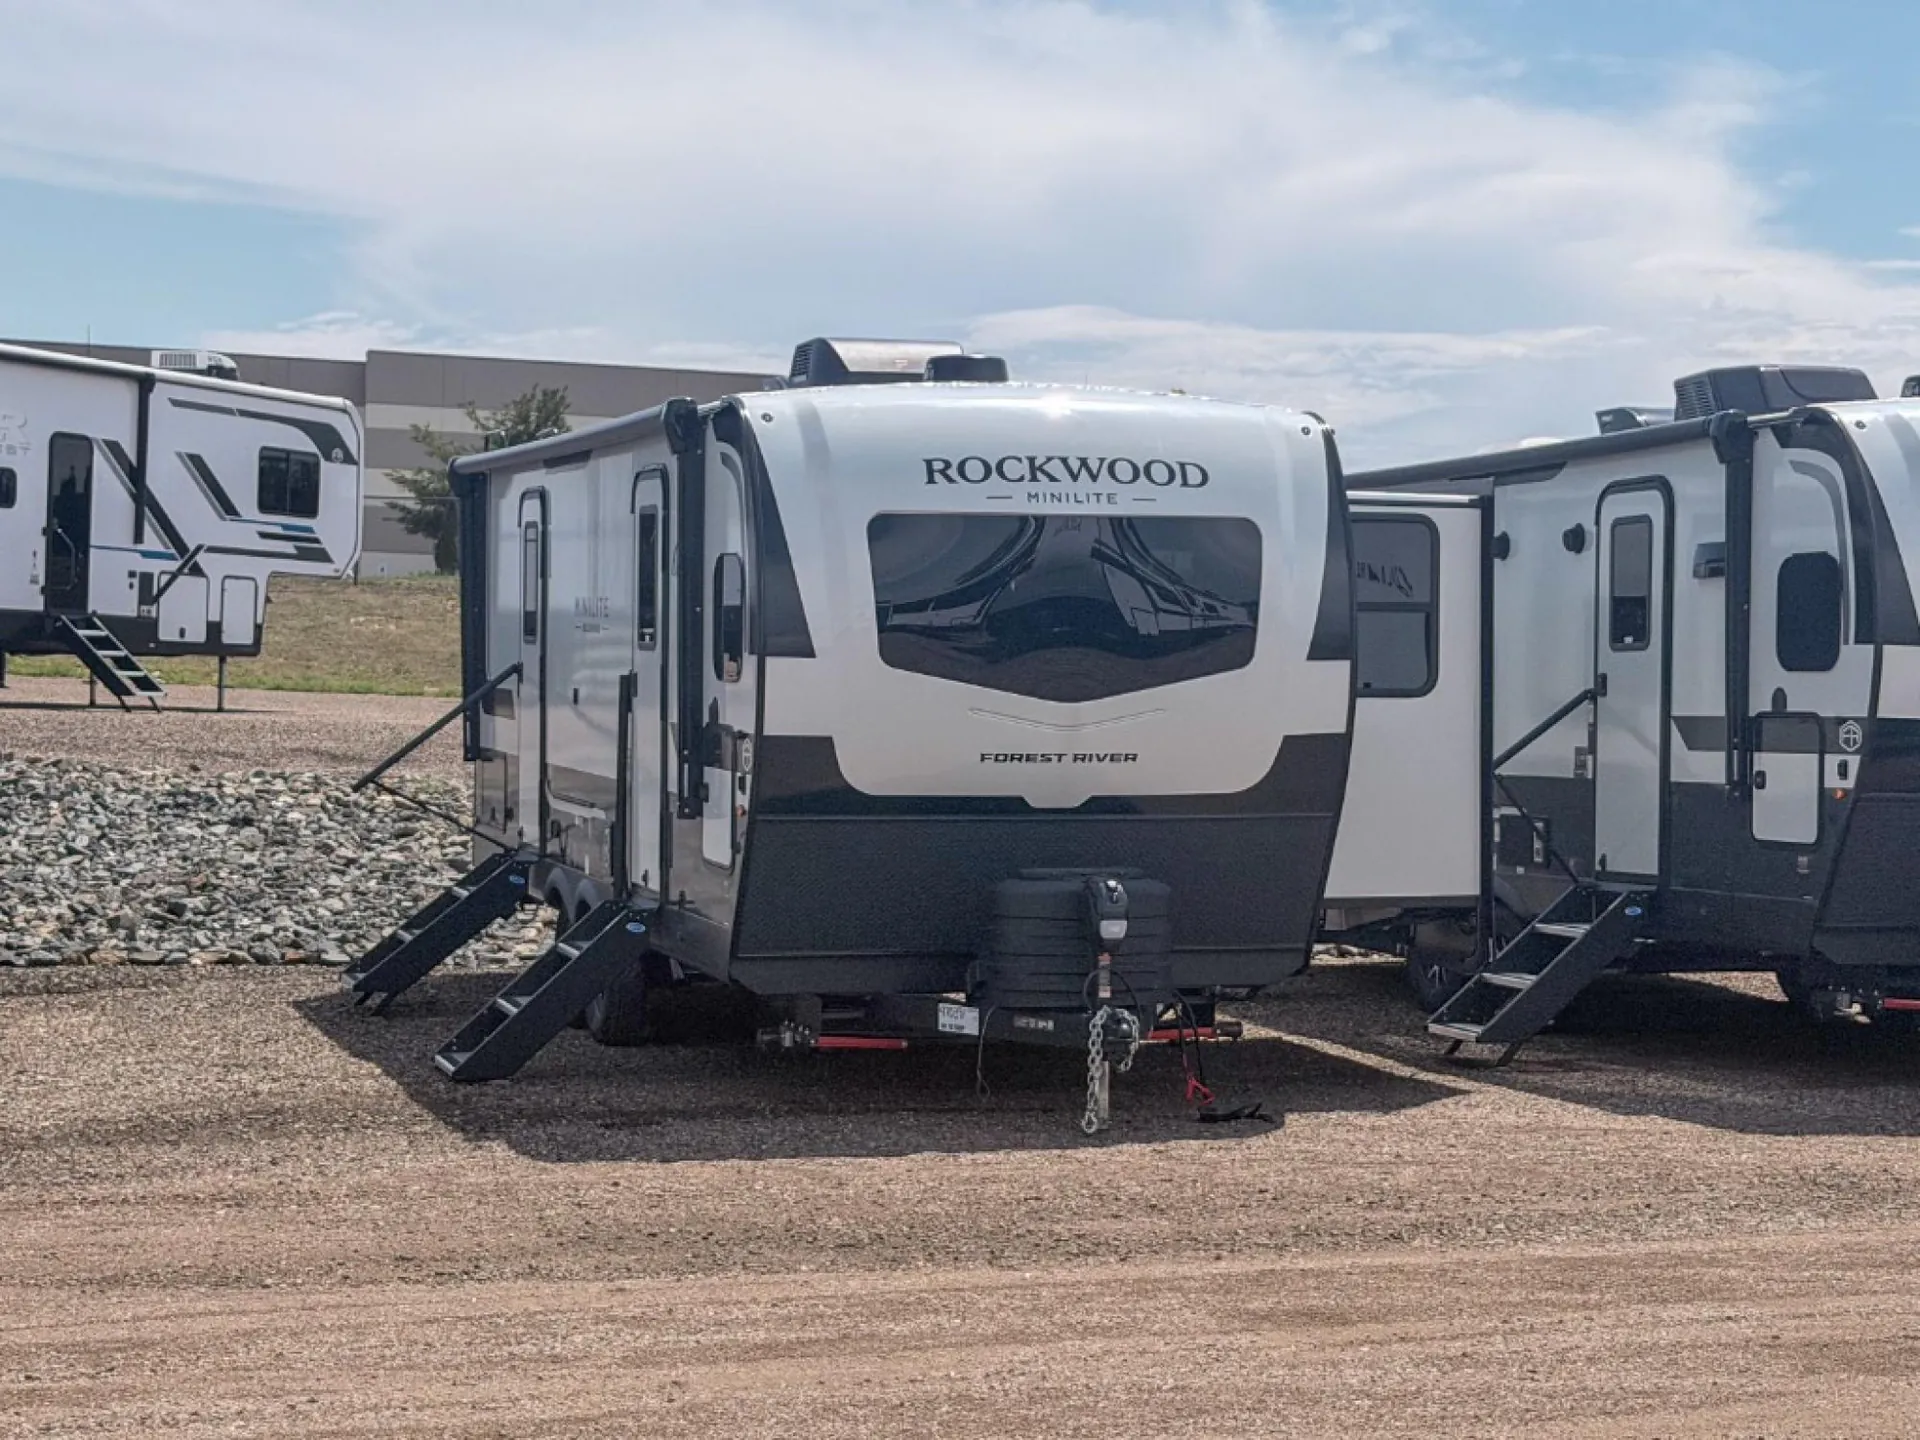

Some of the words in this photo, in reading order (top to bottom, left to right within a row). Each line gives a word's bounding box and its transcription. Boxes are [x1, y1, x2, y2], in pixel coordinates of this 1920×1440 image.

[922, 455, 1210, 488] ROCKWOOD
[1026, 491, 1119, 505] MINILITE
[980, 752, 1068, 764] FOREST
[1072, 752, 1139, 764] RIVER
